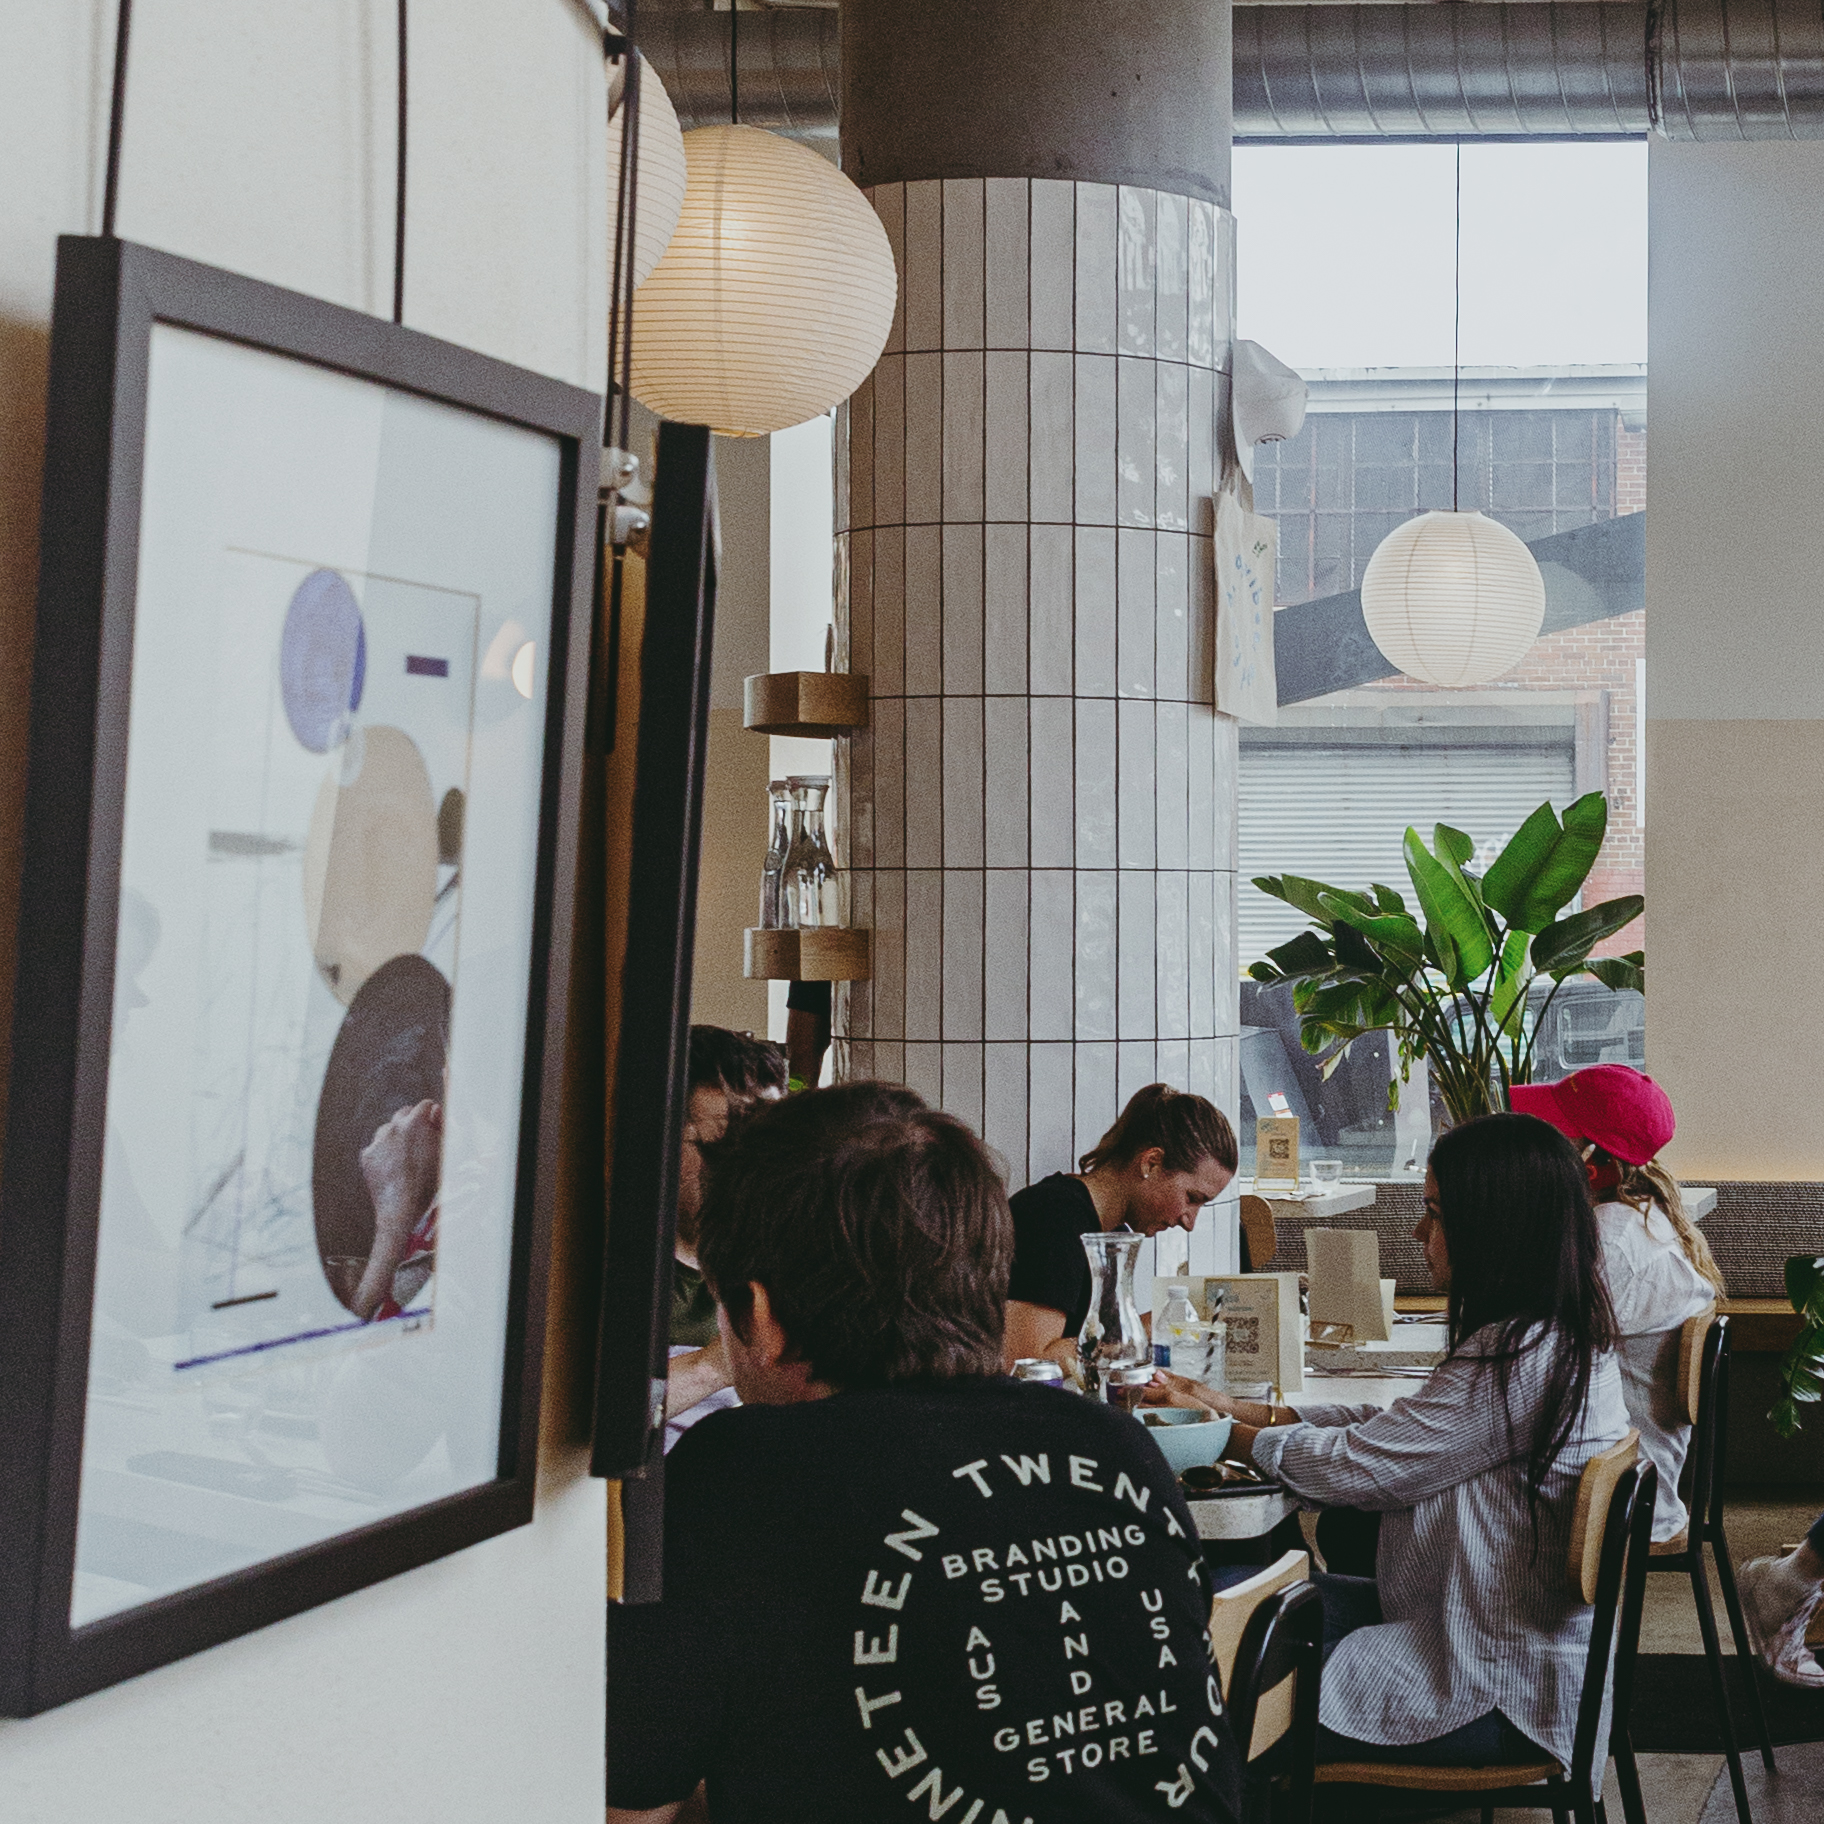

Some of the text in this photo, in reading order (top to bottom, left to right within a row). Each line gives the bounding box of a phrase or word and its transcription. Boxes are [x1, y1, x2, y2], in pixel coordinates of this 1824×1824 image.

[942, 1523, 1146, 1579] BRANDING
[981, 1556, 1129, 1603] STUDIO
[1060, 1600, 1092, 1696] AND
[1141, 1587, 1177, 1669] USA
[965, 1626, 1001, 1711] AUS
[994, 1689, 1178, 1752] GENERAL
[1027, 1730, 1158, 1782] STORE
